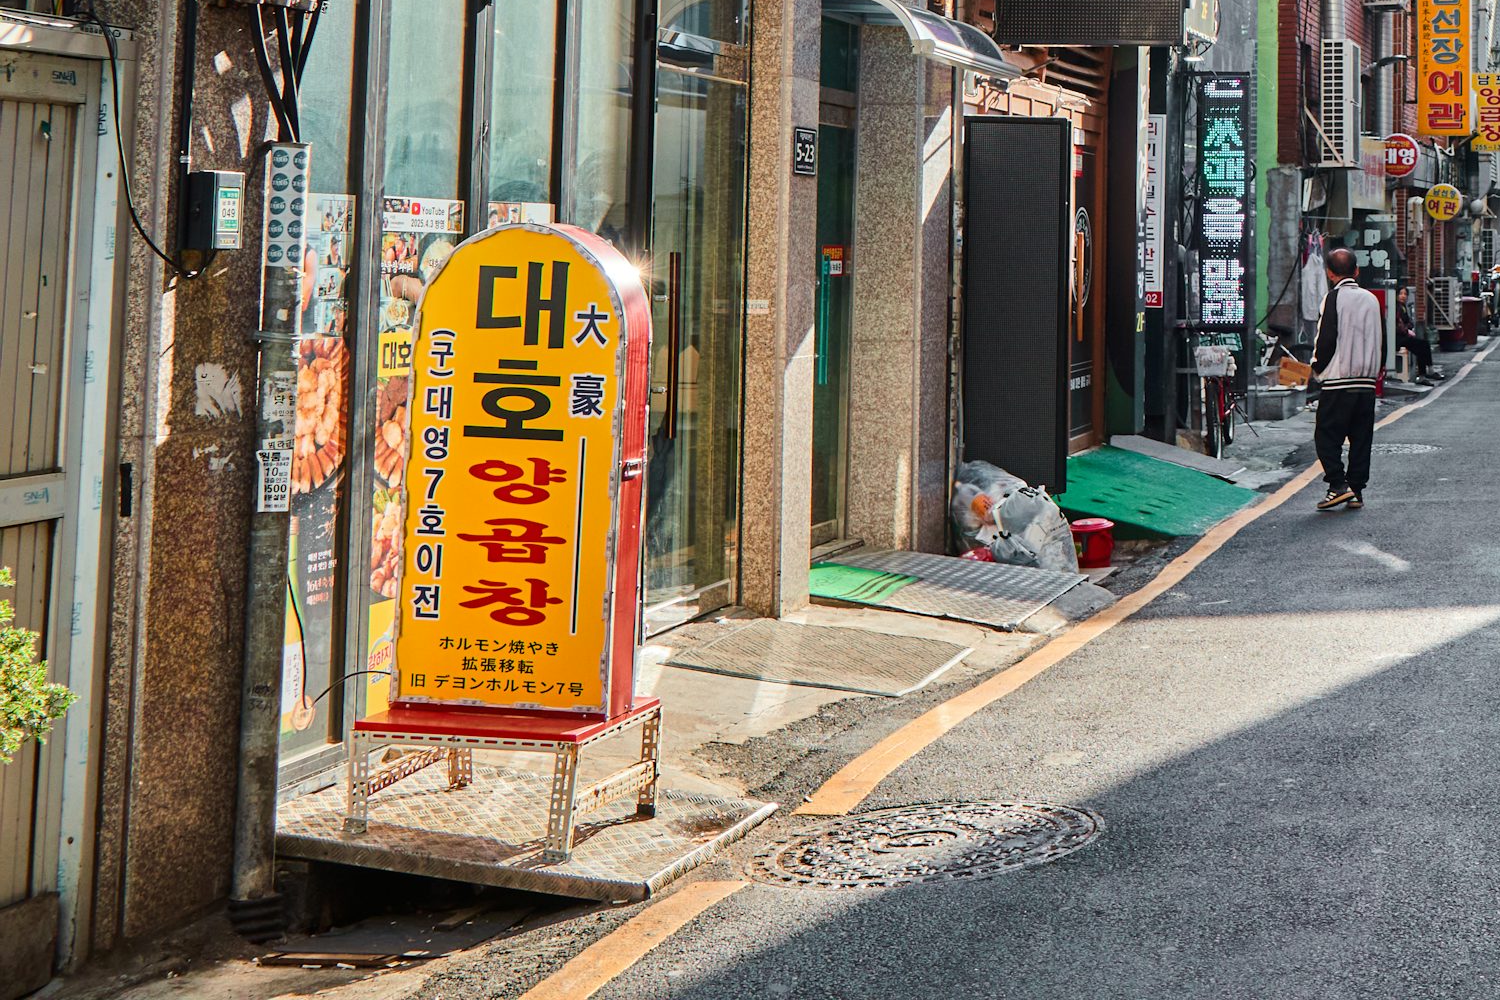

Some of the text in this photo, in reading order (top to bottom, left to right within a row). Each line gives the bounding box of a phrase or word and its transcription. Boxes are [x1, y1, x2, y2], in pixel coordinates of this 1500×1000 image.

[1427, 71, 1466, 130] 여관
[797, 142, 815, 163] 5-23
[221, 208, 236, 218] 049
[421, 206, 445, 216] YouTube
[1428, 200, 1457, 216] 여관
[411, 218, 434, 229] 2025.4.3
[462, 260, 570, 443] 대호
[567, 303, 610, 418] 大豪
[457, 456, 568, 627] 양곱창
[439, 636, 559, 656] ホルモン焼やき
[461, 656, 534, 675] 拡張移転
[410, 673, 425, 688] 旧
[434, 674, 584, 697] デヨンホルモン7号
